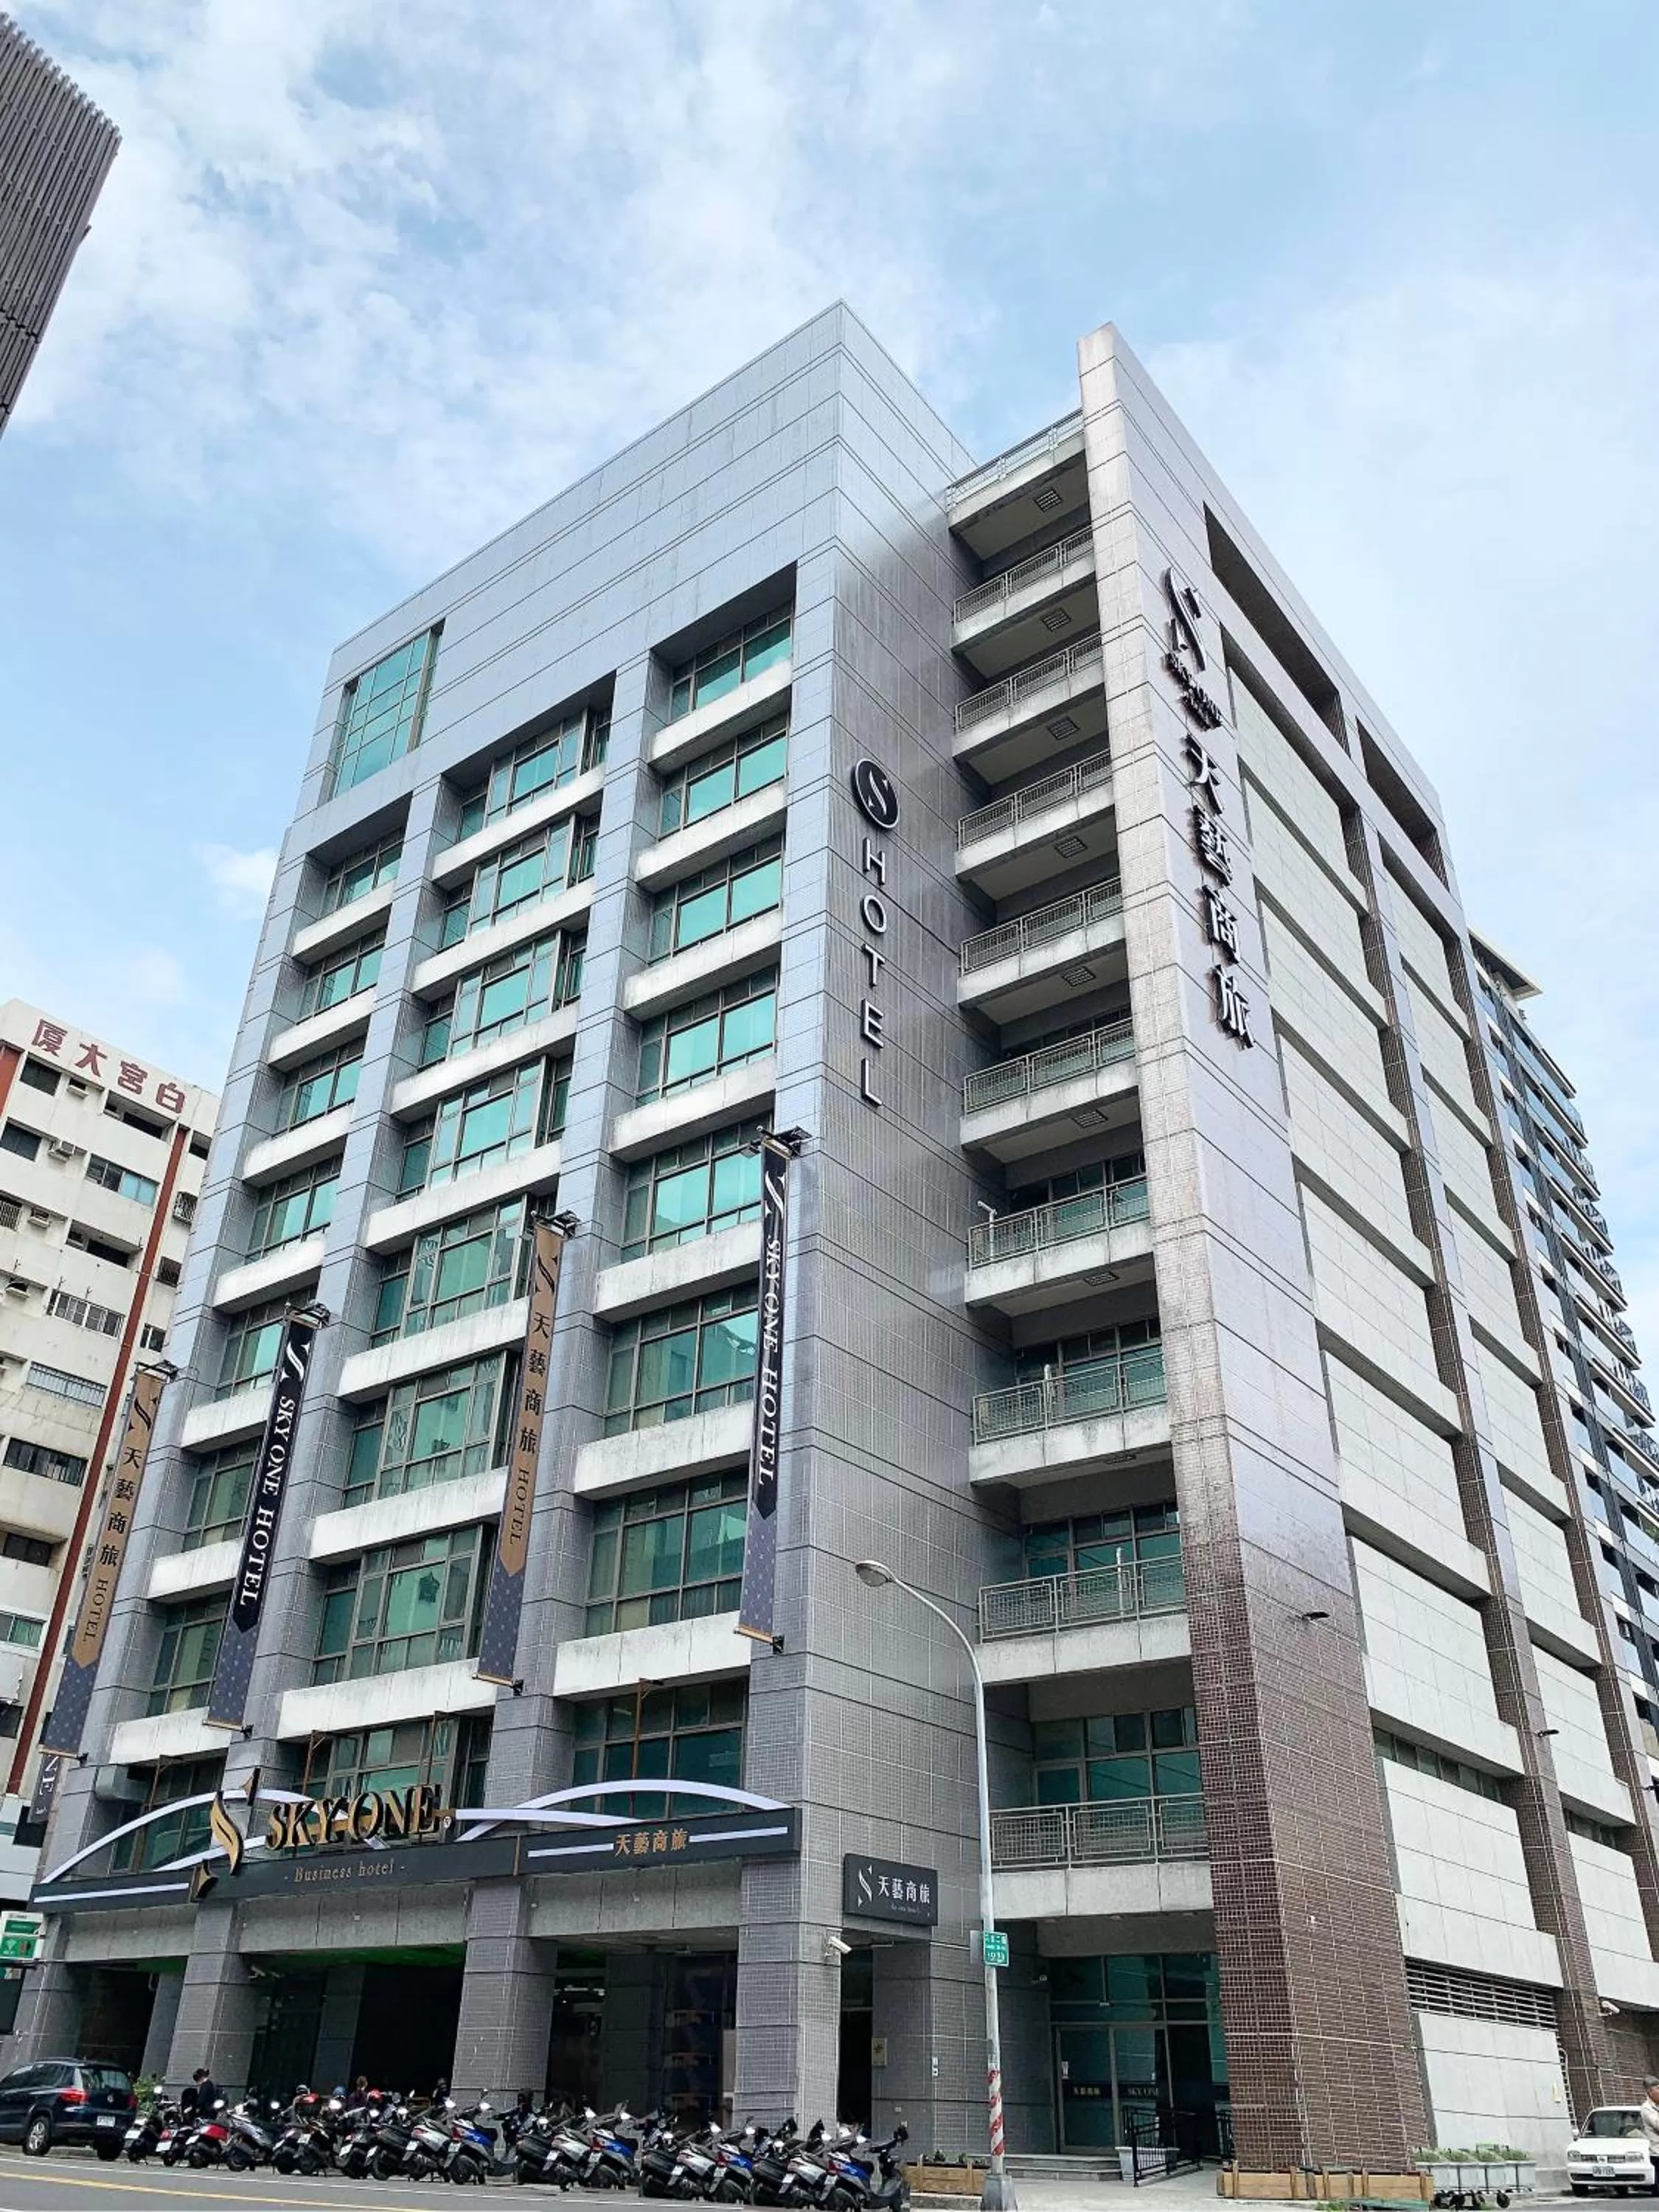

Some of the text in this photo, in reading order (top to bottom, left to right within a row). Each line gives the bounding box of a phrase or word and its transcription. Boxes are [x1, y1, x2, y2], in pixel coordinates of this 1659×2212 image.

[861, 838, 886, 1106] HOTEL
[518, 1311, 550, 1455] 天藝商旅
[759, 1235, 781, 1485] SKY ONE HOTEL
[100, 1446, 142, 1567] 天藝商旅
[239, 1396, 295, 1608] SKY ONE HOTEL
[508, 1468, 530, 1545] HOTEL
[82, 1579, 108, 1644] HOTEL
[295, 1857, 394, 1882] Business hotel
[615, 1829, 688, 1857] 天藝商旅
[877, 1876, 930, 1904] 天藝商旅
